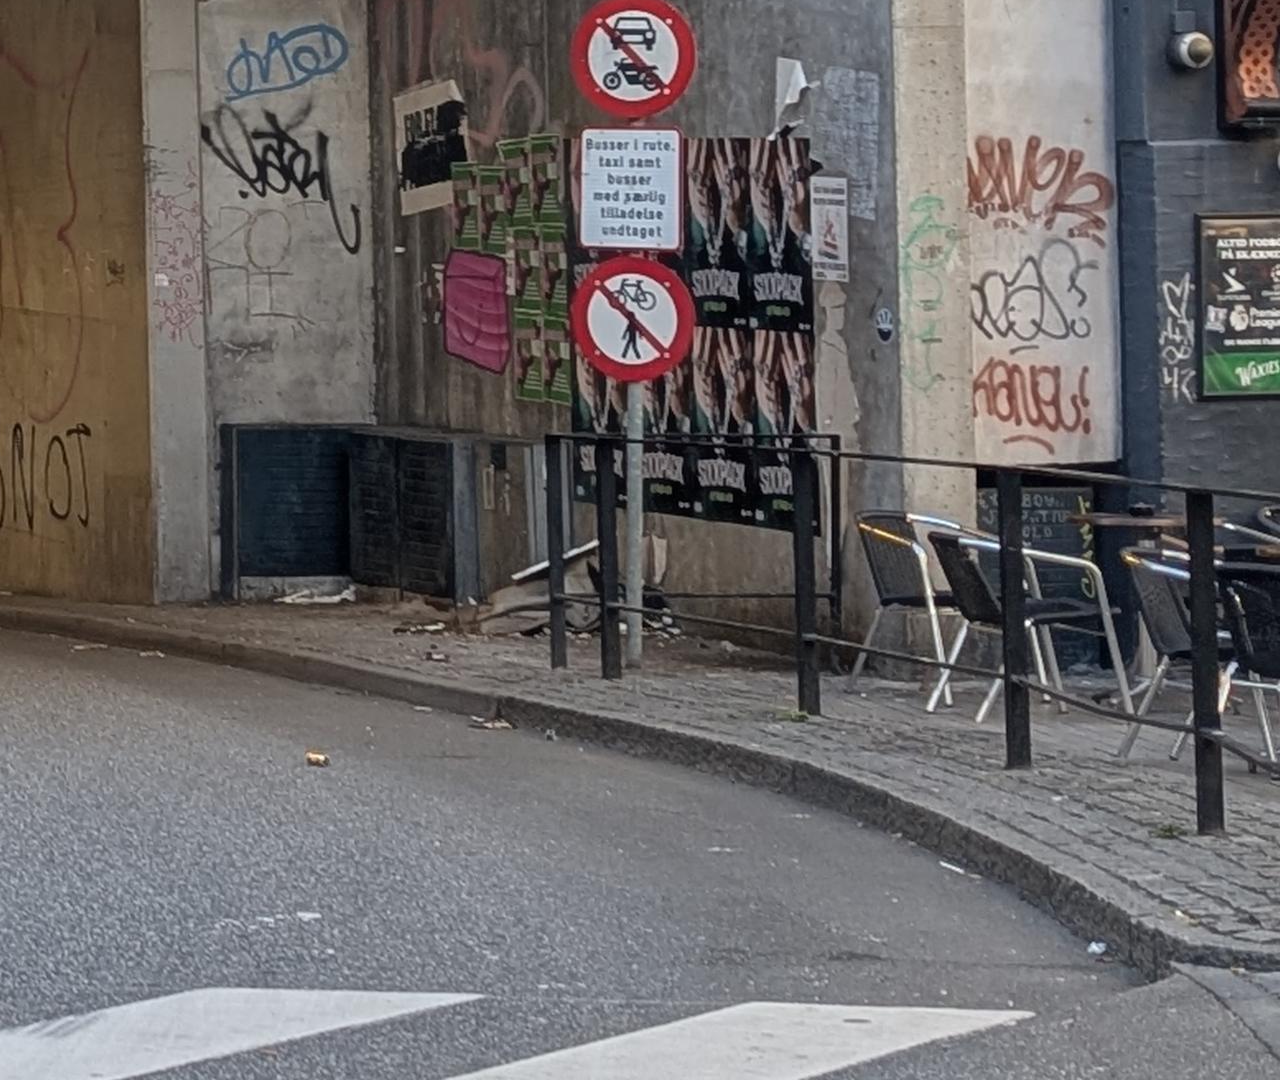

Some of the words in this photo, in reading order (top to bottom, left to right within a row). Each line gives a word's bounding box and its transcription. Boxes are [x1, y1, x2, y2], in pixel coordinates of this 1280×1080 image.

[586, 138, 630, 151] Busser
[598, 156, 624, 168] taxi
[628, 157, 662, 169] samt
[607, 173, 652, 186] busser
[593, 190, 620, 202] med
[600, 206, 664, 220] tilladelse
[601, 224, 663, 239] undtaget
